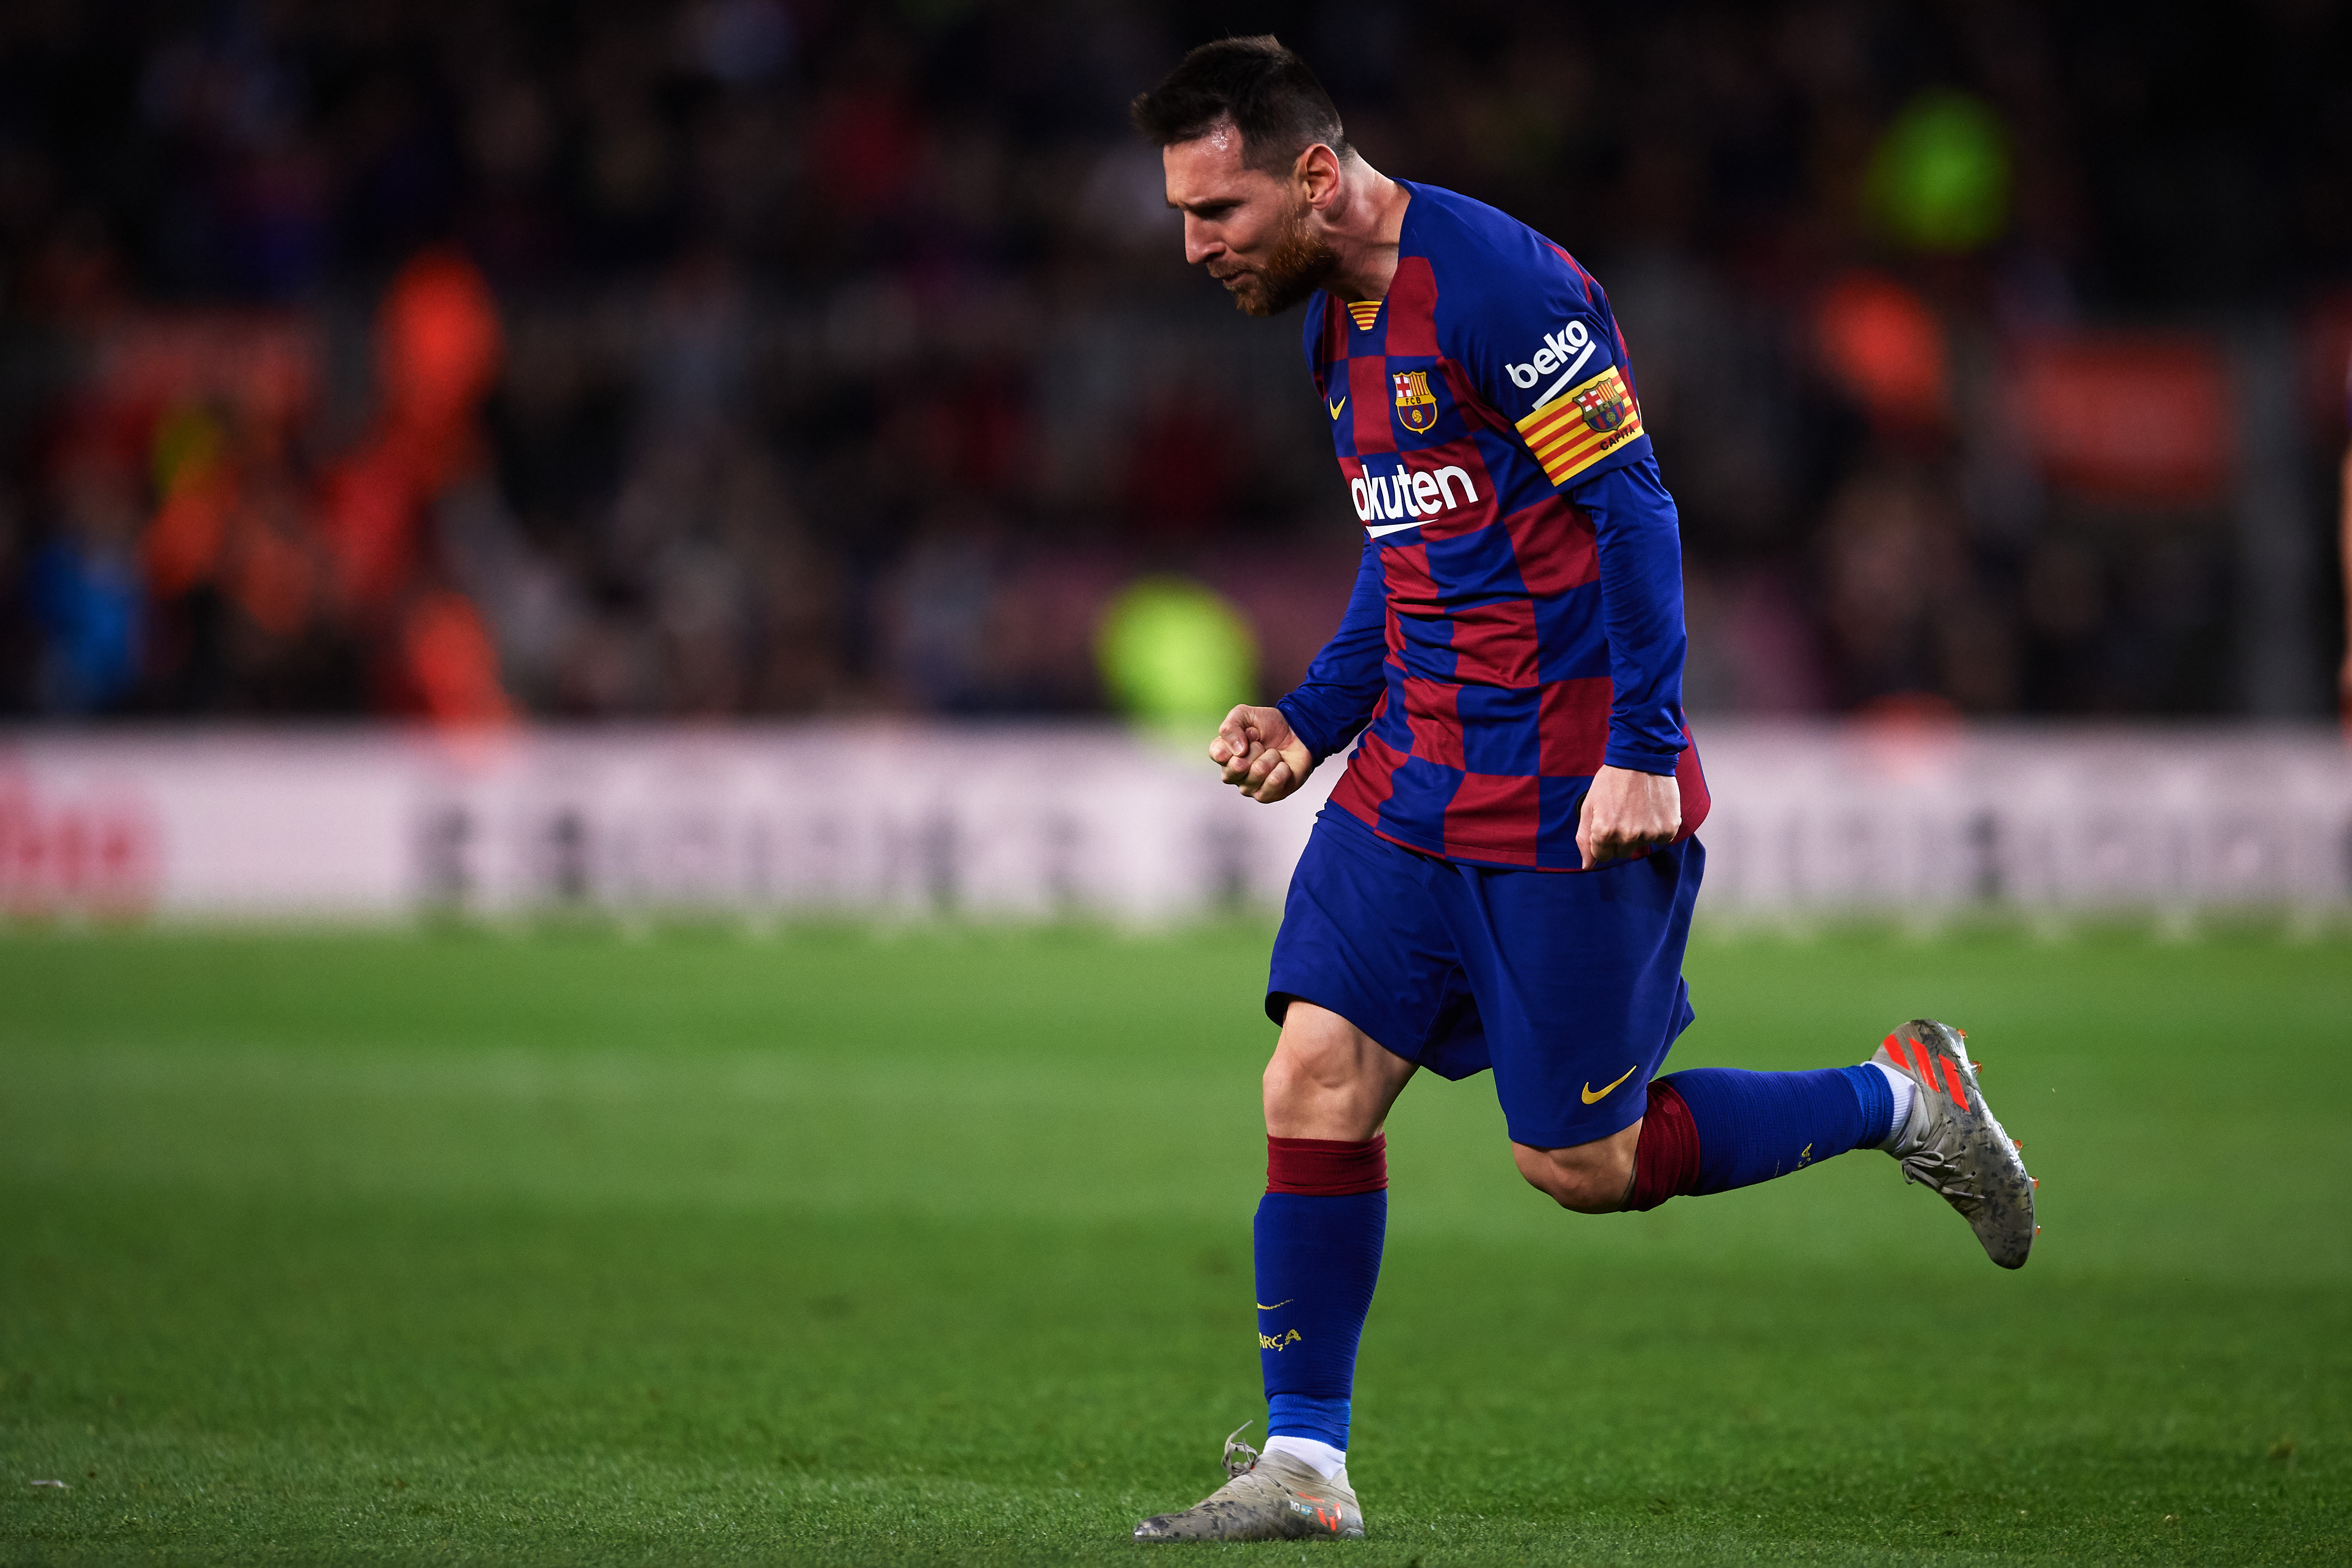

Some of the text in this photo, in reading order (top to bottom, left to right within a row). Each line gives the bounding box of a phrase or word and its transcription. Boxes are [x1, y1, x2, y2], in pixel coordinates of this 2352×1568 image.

[1504, 320, 1588, 389] beko
[1405, 397, 1422, 405] FCB
[1596, 401, 1613, 412] FCB
[1351, 464, 1479, 521] akuten
[1258, 1328, 1302, 1352] ARÇA
[1289, 1501, 1300, 1512] 10
